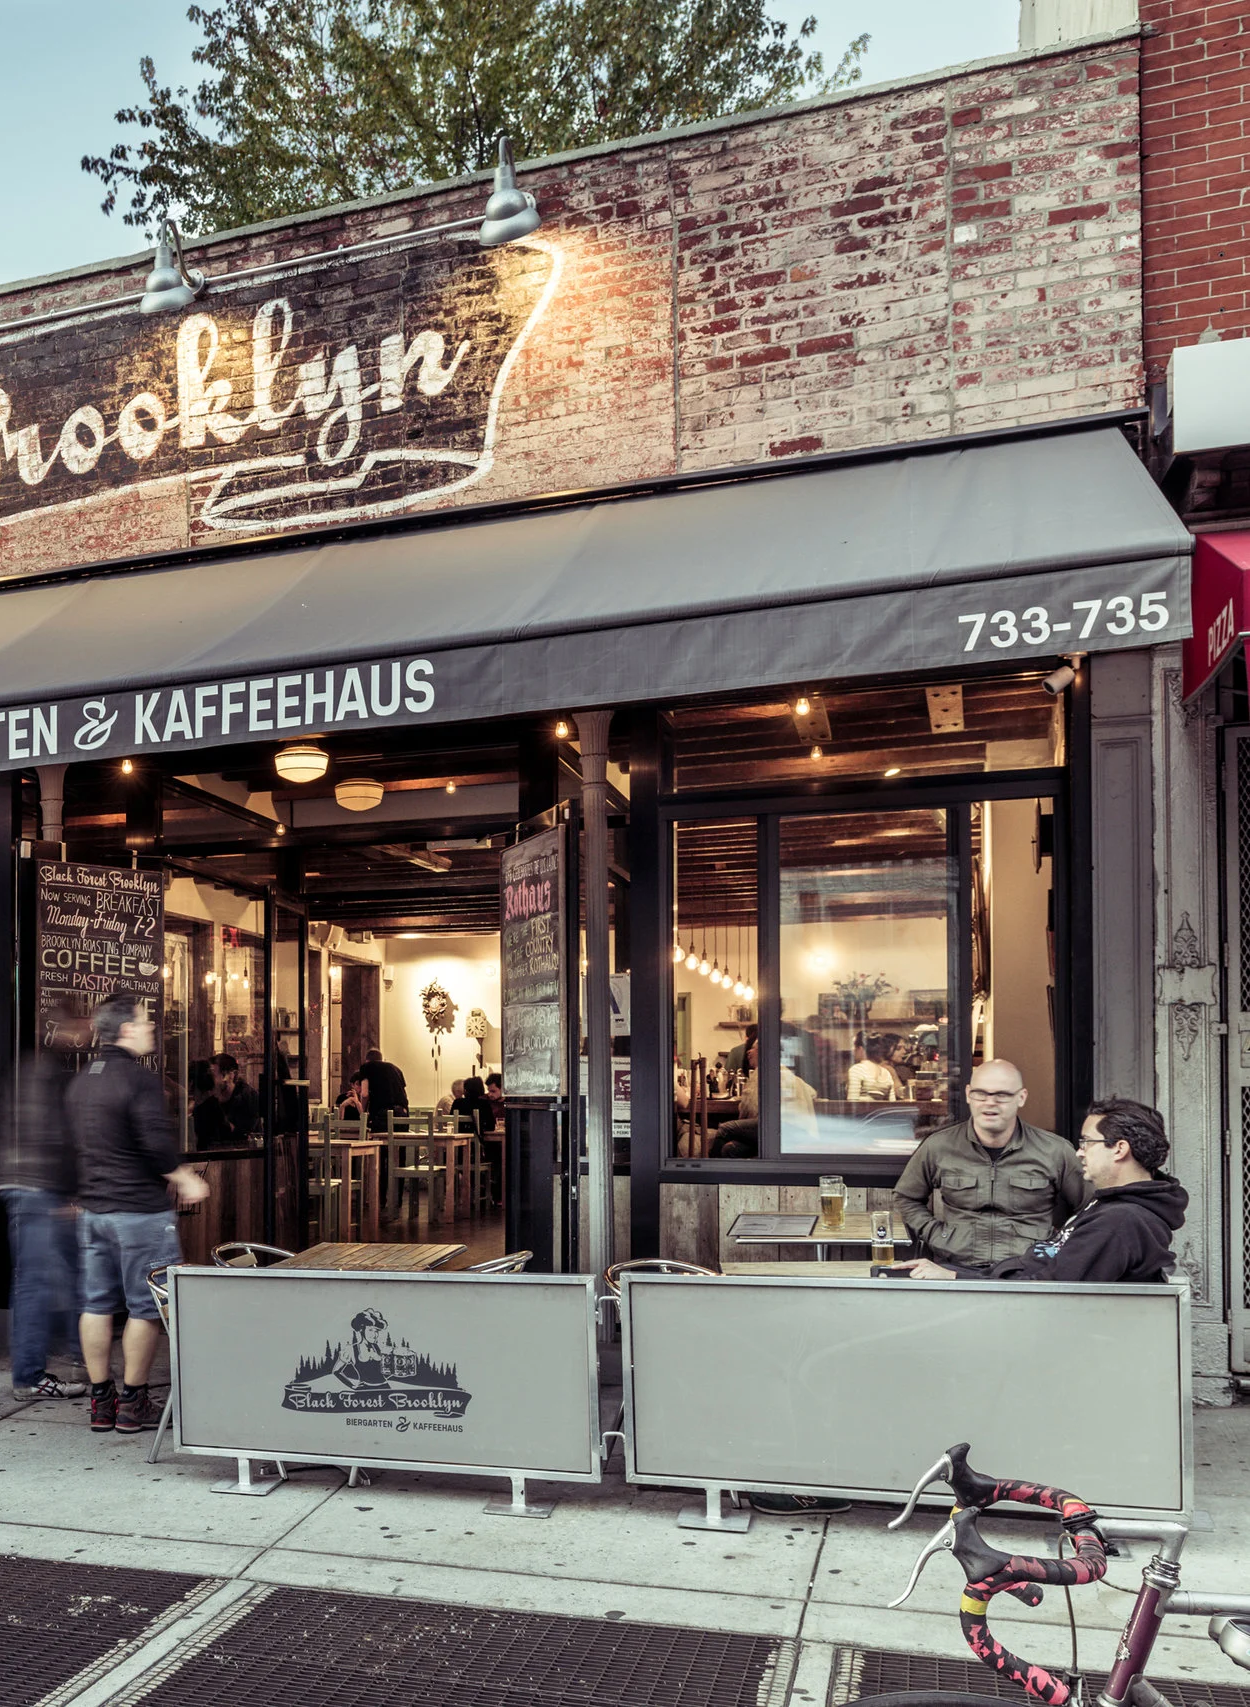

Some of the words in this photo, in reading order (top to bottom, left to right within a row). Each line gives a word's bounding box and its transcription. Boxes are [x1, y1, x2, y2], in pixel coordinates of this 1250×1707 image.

[958, 591, 1169, 652] 733-735
[1208, 597, 1234, 667] PIZZA
[72, 696, 119, 751] &
[134, 658, 436, 745] KAFFEEHAUS
[40, 865, 73, 886] Black
[76, 867, 108, 888] Forest
[109, 870, 160, 899] Brooklyn
[63, 892, 91, 907] SERVING
[96, 891, 161, 917] BREAKFAST
[41, 934, 81, 952] BROOKLYN
[82, 939, 119, 956] ROASTING
[122, 943, 153, 960] COMPANY
[41, 949, 136, 977] COFFEE
[40, 970, 69, 983] FRESH
[73, 973, 118, 993] PASTRY
[40, 998, 62, 1008] MANNE
[288, 1391, 337, 1410] Black
[339, 1390, 386, 1409] Forest
[388, 1392, 464, 1414] Brooklyn
[346, 1417, 393, 1428] BIERGARTEN
[413, 1421, 464, 1433] KAFFEEHAUS
